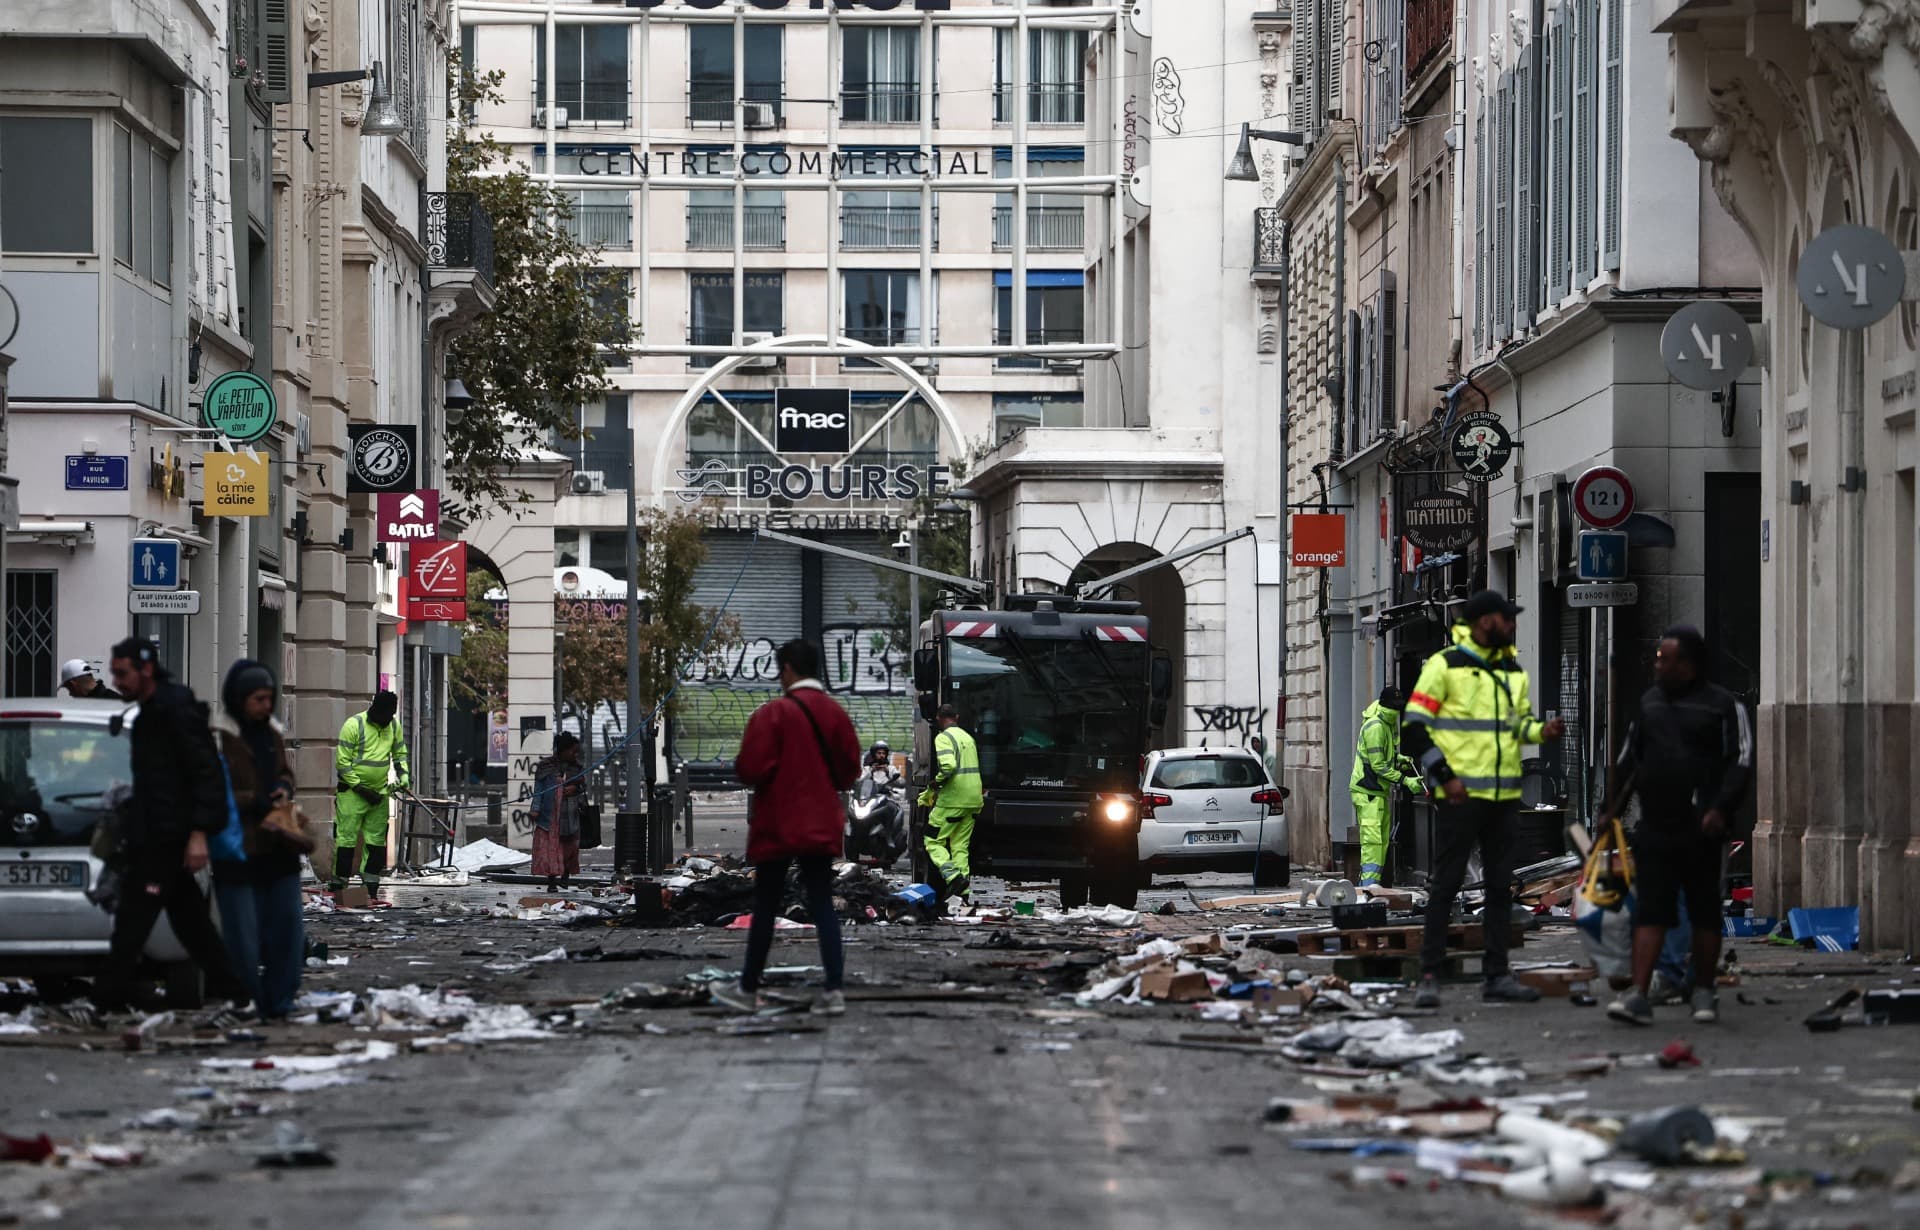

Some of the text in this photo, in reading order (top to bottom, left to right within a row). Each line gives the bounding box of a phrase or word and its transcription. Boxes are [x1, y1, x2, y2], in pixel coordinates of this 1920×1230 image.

[579, 151, 988, 176] CENTRE COMMERCIAL
[218, 387, 257, 404] LE PETIT
[217, 402, 264, 420] VAPOTEUR
[779, 407, 846, 429] fnac
[1462, 412, 1501, 423] KILO SHOP
[357, 432, 406, 457] BOUCHARA
[746, 464, 951, 501] BOURSE
[1464, 472, 1485, 482] SINCE
[216, 481, 255, 493] la mie
[216, 493, 256, 505] câline
[1421, 499, 1454, 508] COMPTOIR
[1590, 491, 1608, 506] 12
[1406, 508, 1476, 526] MATHILDE
[388, 522, 436, 539] BATTLE
[1295, 552, 1338, 564] orange
[1031, 779, 1064, 787] schmidt
